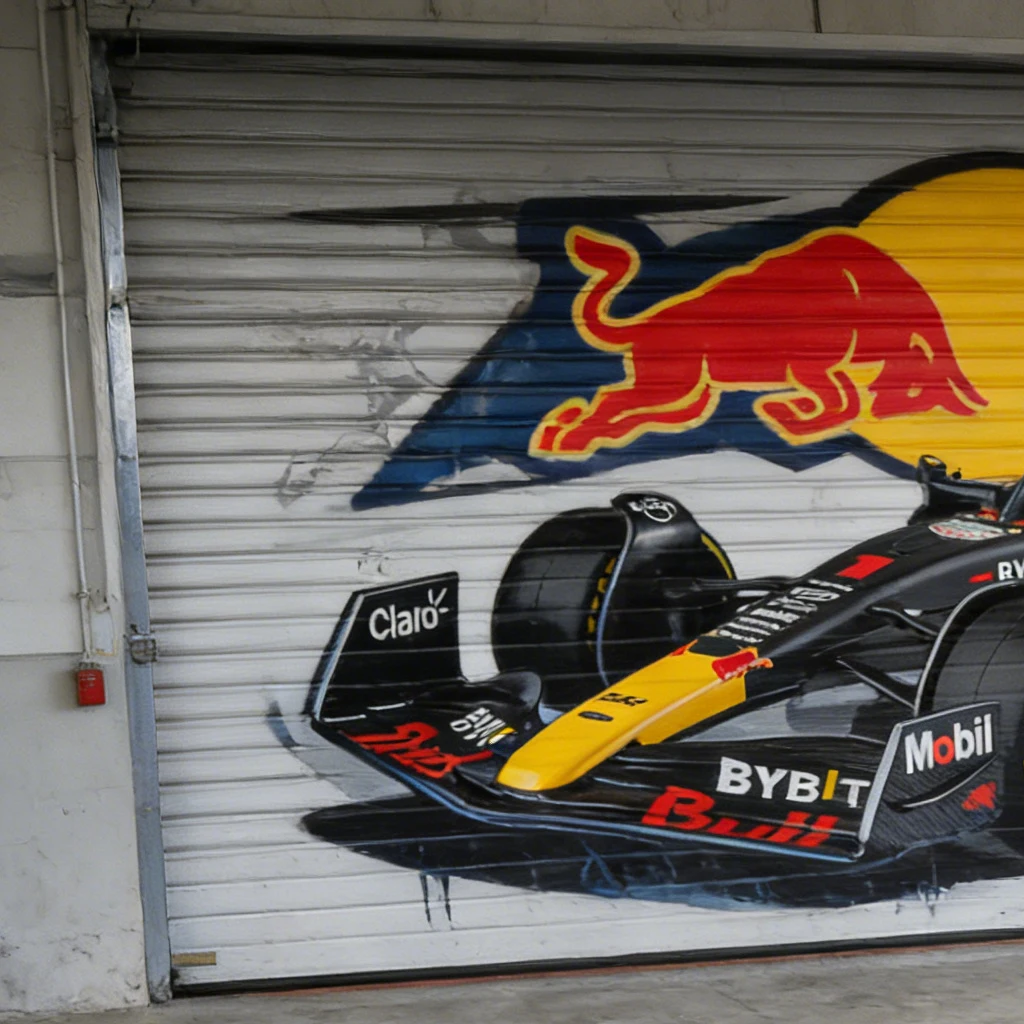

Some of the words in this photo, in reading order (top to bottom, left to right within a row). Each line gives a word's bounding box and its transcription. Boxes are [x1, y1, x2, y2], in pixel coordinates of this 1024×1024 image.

[836, 554, 895, 580] 1
[368, 594, 443, 641] Claro
[905, 714, 993, 775] Mobil
[715, 756, 871, 809] BYBIT
[640, 785, 839, 848] Bull
